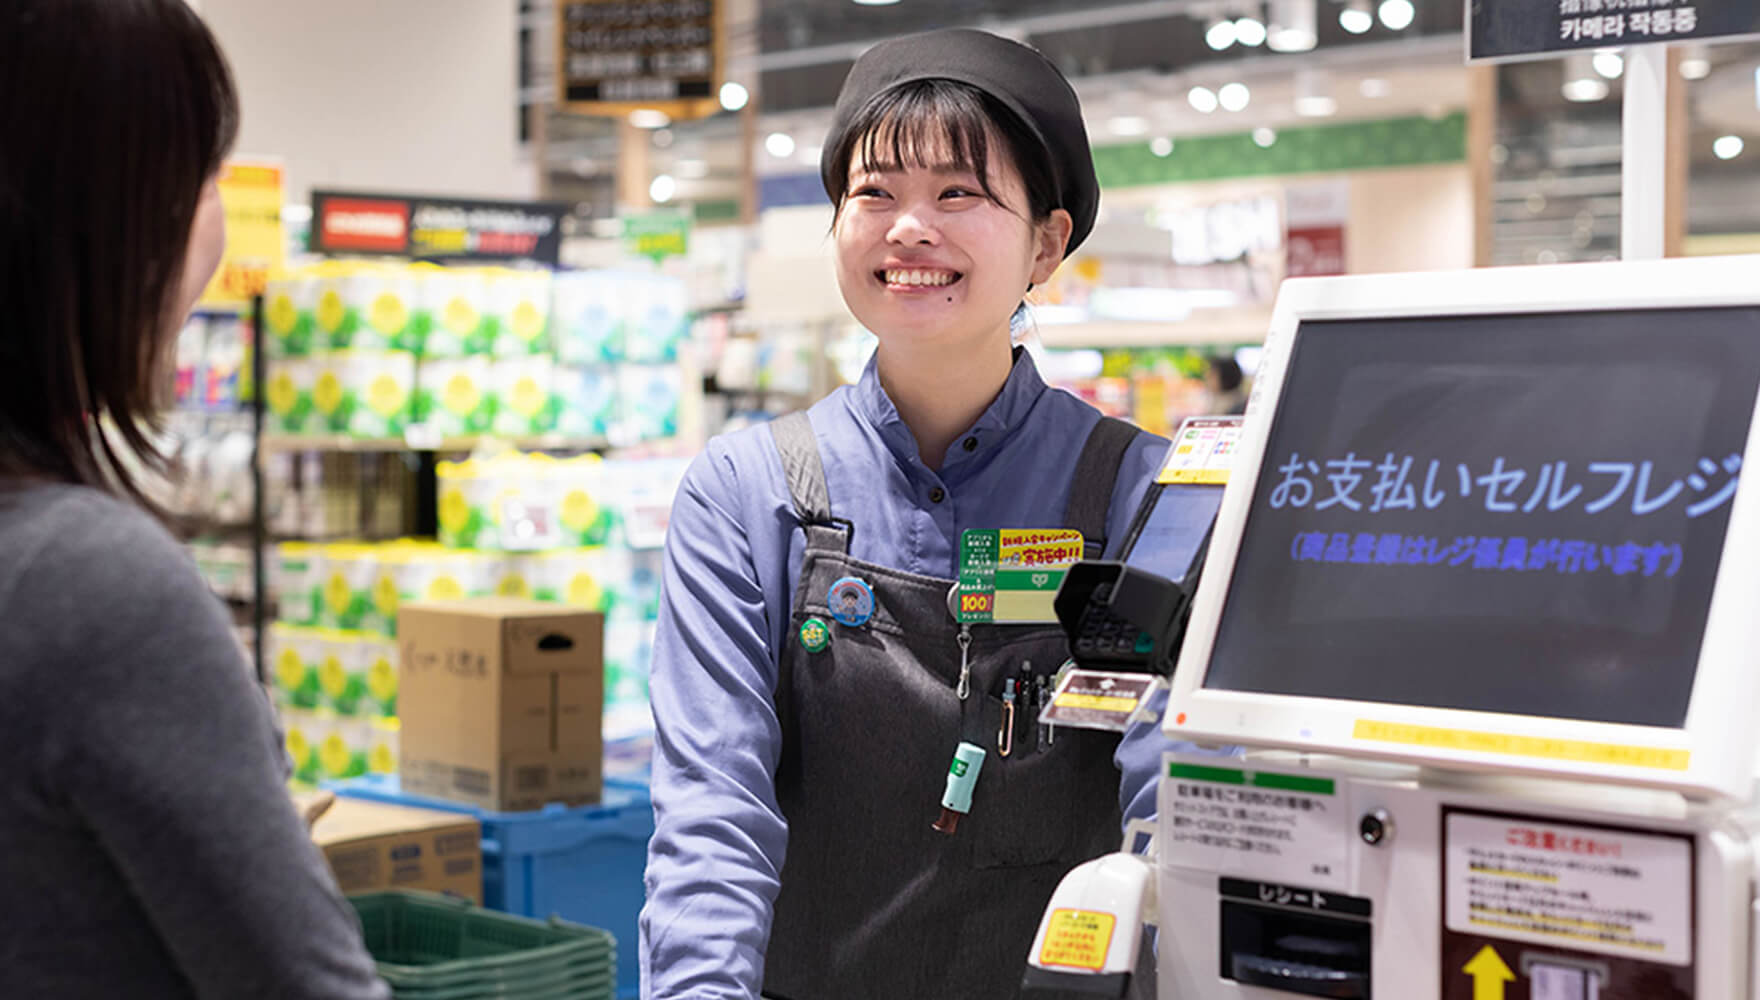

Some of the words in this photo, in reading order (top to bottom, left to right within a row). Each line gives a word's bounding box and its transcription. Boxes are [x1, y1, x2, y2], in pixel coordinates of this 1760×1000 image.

[1560, 14, 1625, 41] 카메라
[1629, 7, 1698, 35] 작동중
[1270, 453, 1743, 517] お支払いセルフレジ
[1022, 547, 1080, 566] 実施中!!
[1259, 884, 1327, 909] レシート
